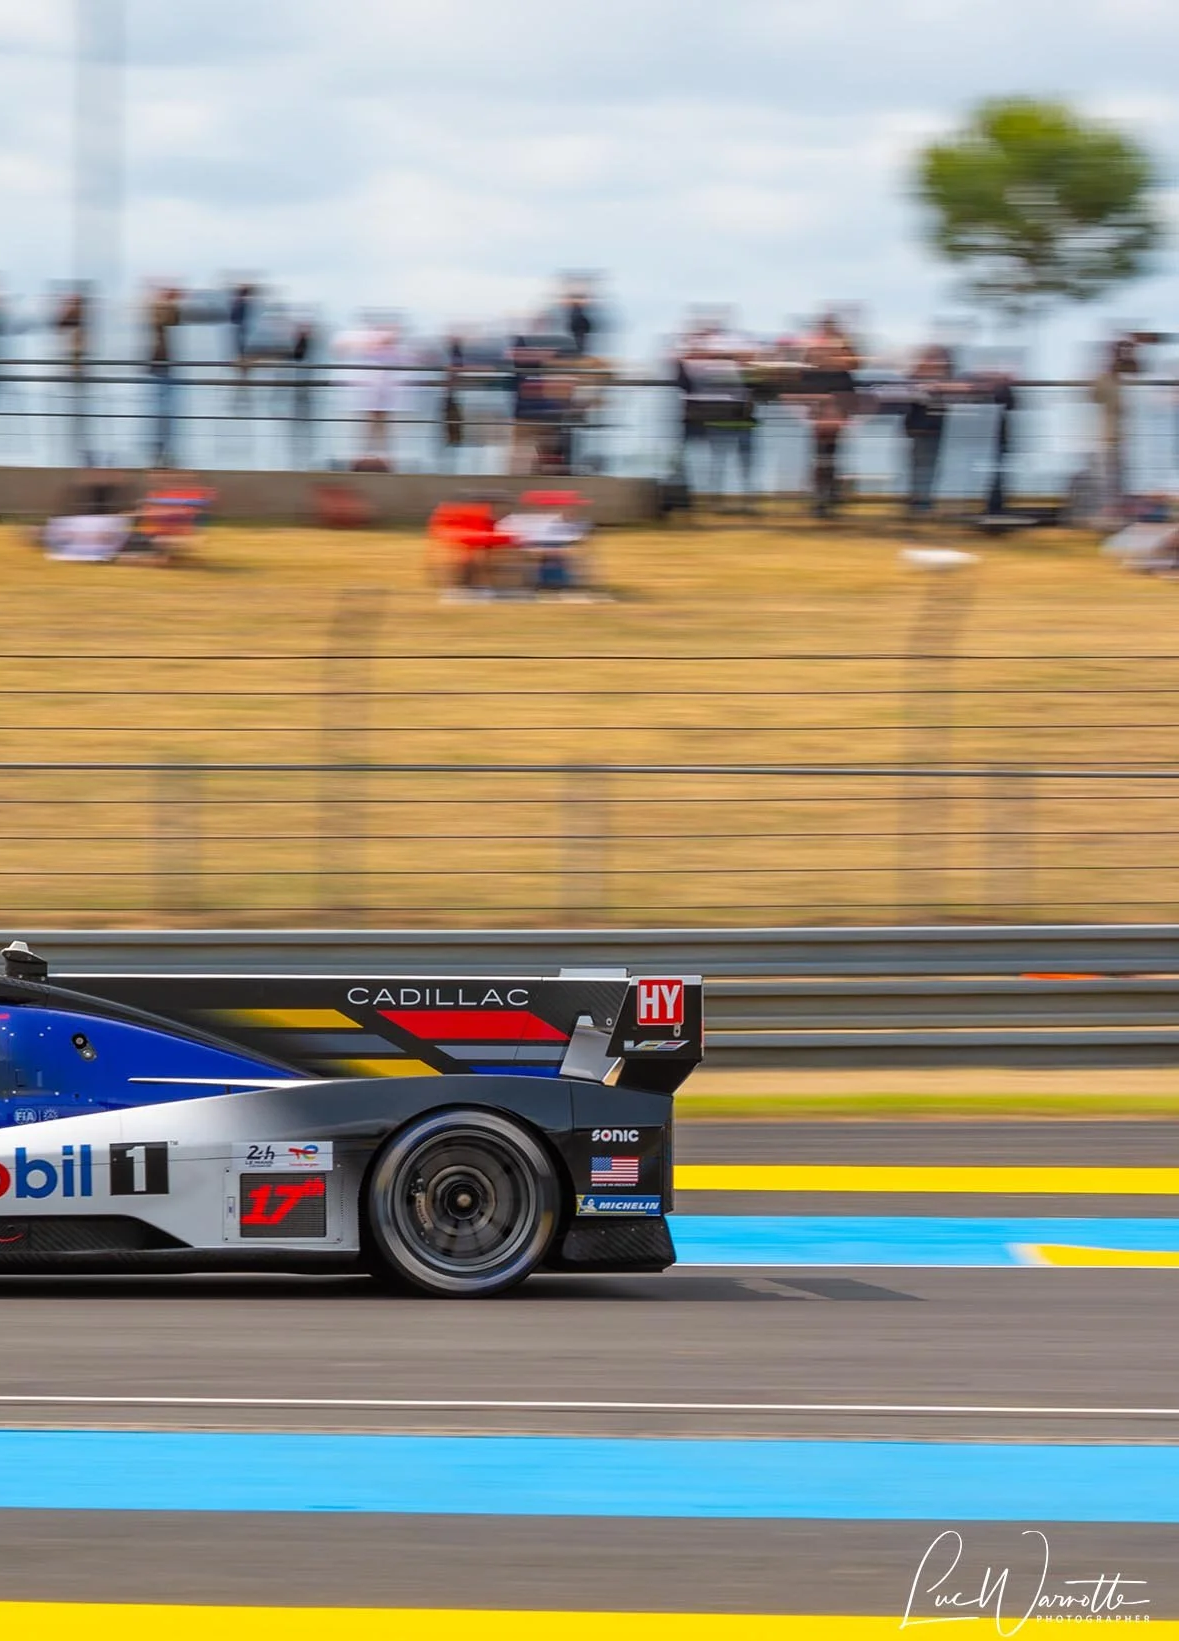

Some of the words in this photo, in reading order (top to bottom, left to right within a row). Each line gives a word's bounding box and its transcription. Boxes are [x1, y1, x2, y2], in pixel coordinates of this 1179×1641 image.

[347, 987, 529, 1006] CADILLAC
[640, 985, 681, 1019] HY
[125, 1145, 148, 1193] 1
[598, 1202, 660, 1210] MICHELIN
